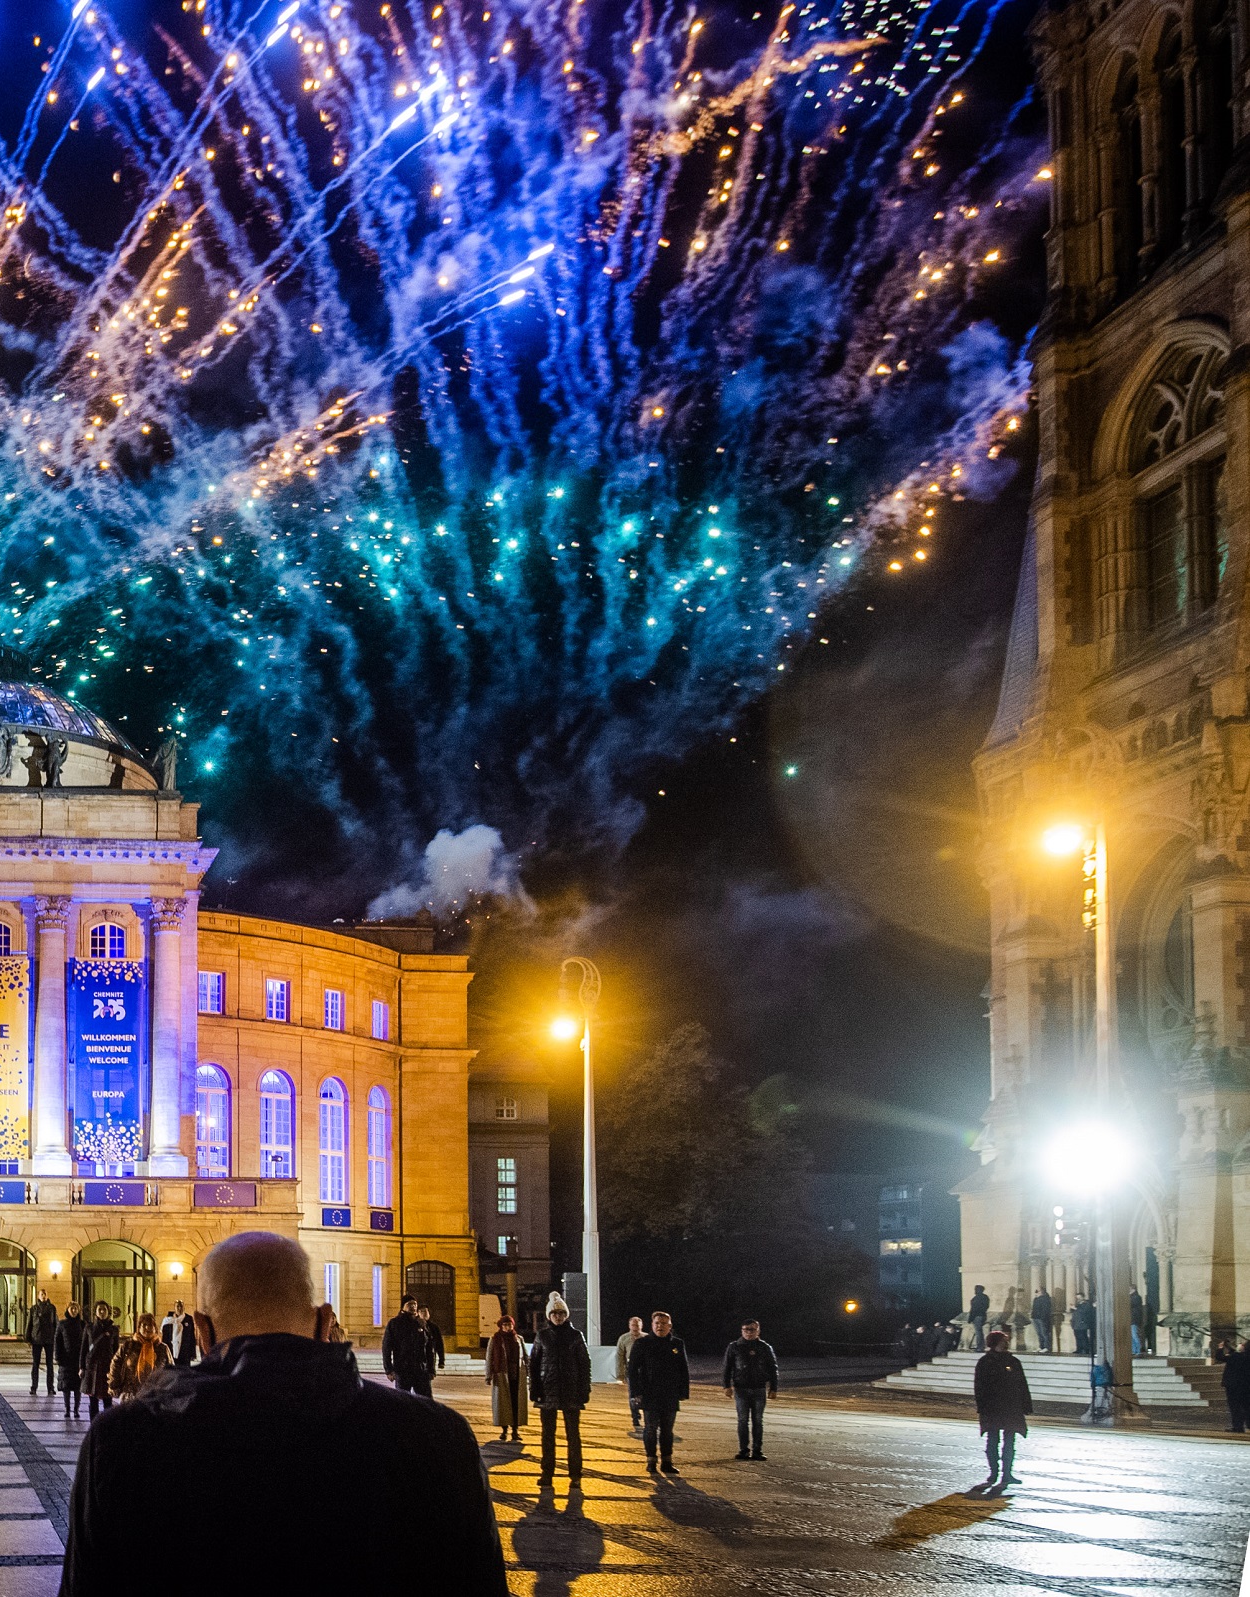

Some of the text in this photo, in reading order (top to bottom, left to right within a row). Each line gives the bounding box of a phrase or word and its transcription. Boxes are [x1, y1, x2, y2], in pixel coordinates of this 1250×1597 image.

[81, 1034, 137, 1042] WILLKOMMEN
[86, 1045, 132, 1053] BIENVENUE
[89, 1057, 129, 1065] WELCOME
[92, 1090, 125, 1099] EUROPA
